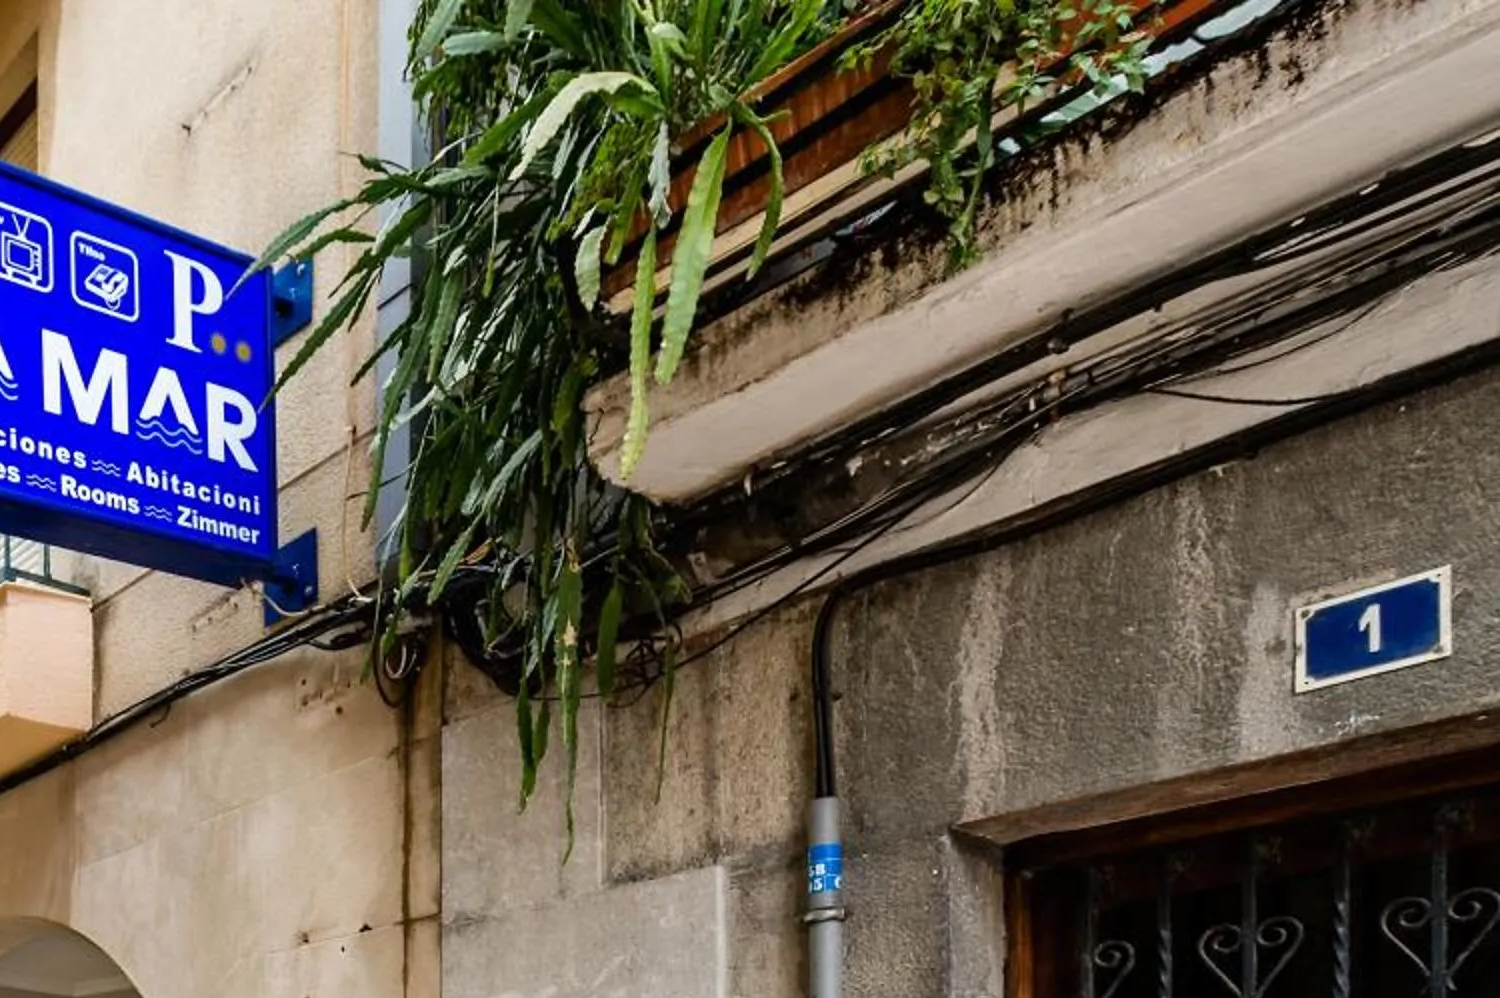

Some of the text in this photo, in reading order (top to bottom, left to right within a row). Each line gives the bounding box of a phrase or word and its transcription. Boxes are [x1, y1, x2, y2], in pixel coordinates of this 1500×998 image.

[164, 249, 224, 353] P
[41, 328, 259, 473] MAR
[60, 476, 140, 515] Rooms
[176, 505, 261, 546] Zimmer
[126, 461, 261, 516] Abitacioni
[1358, 603, 1381, 653] 1
